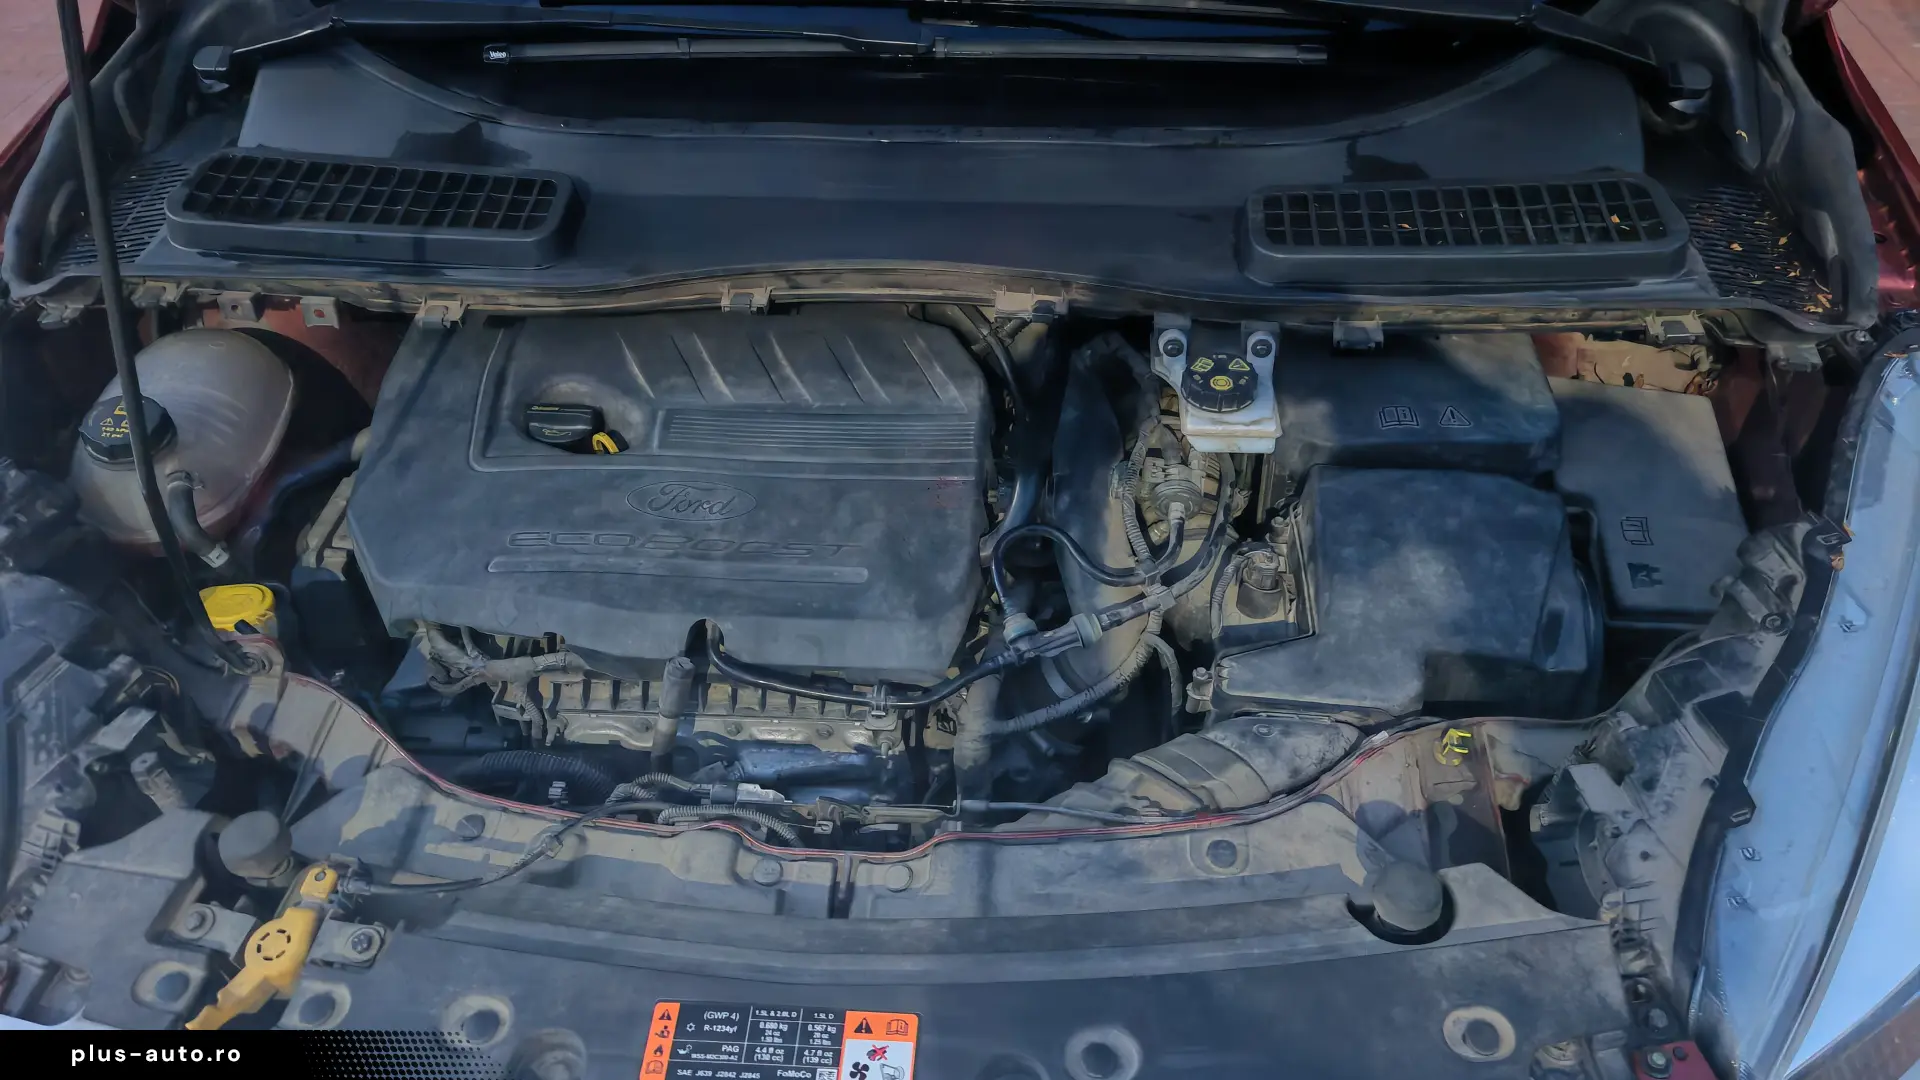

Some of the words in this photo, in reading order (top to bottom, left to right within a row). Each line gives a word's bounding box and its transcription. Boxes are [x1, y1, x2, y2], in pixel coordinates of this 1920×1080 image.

[647, 483, 737, 516] Ford
[507, 531, 863, 558] ECOBOOST
[703, 1010, 729, 1020] (GWP
[730, 1012, 740, 1021] 4)
[703, 1024, 738, 1034] R-1234yf
[779, 1023, 788, 1031] kg
[827, 1025, 836, 1033] kg
[721, 1044, 740, 1053] PAG
[771, 1054, 784, 1062] cc)
[820, 1057, 833, 1065] cc)
[776, 1069, 812, 1078] FoMoCo
